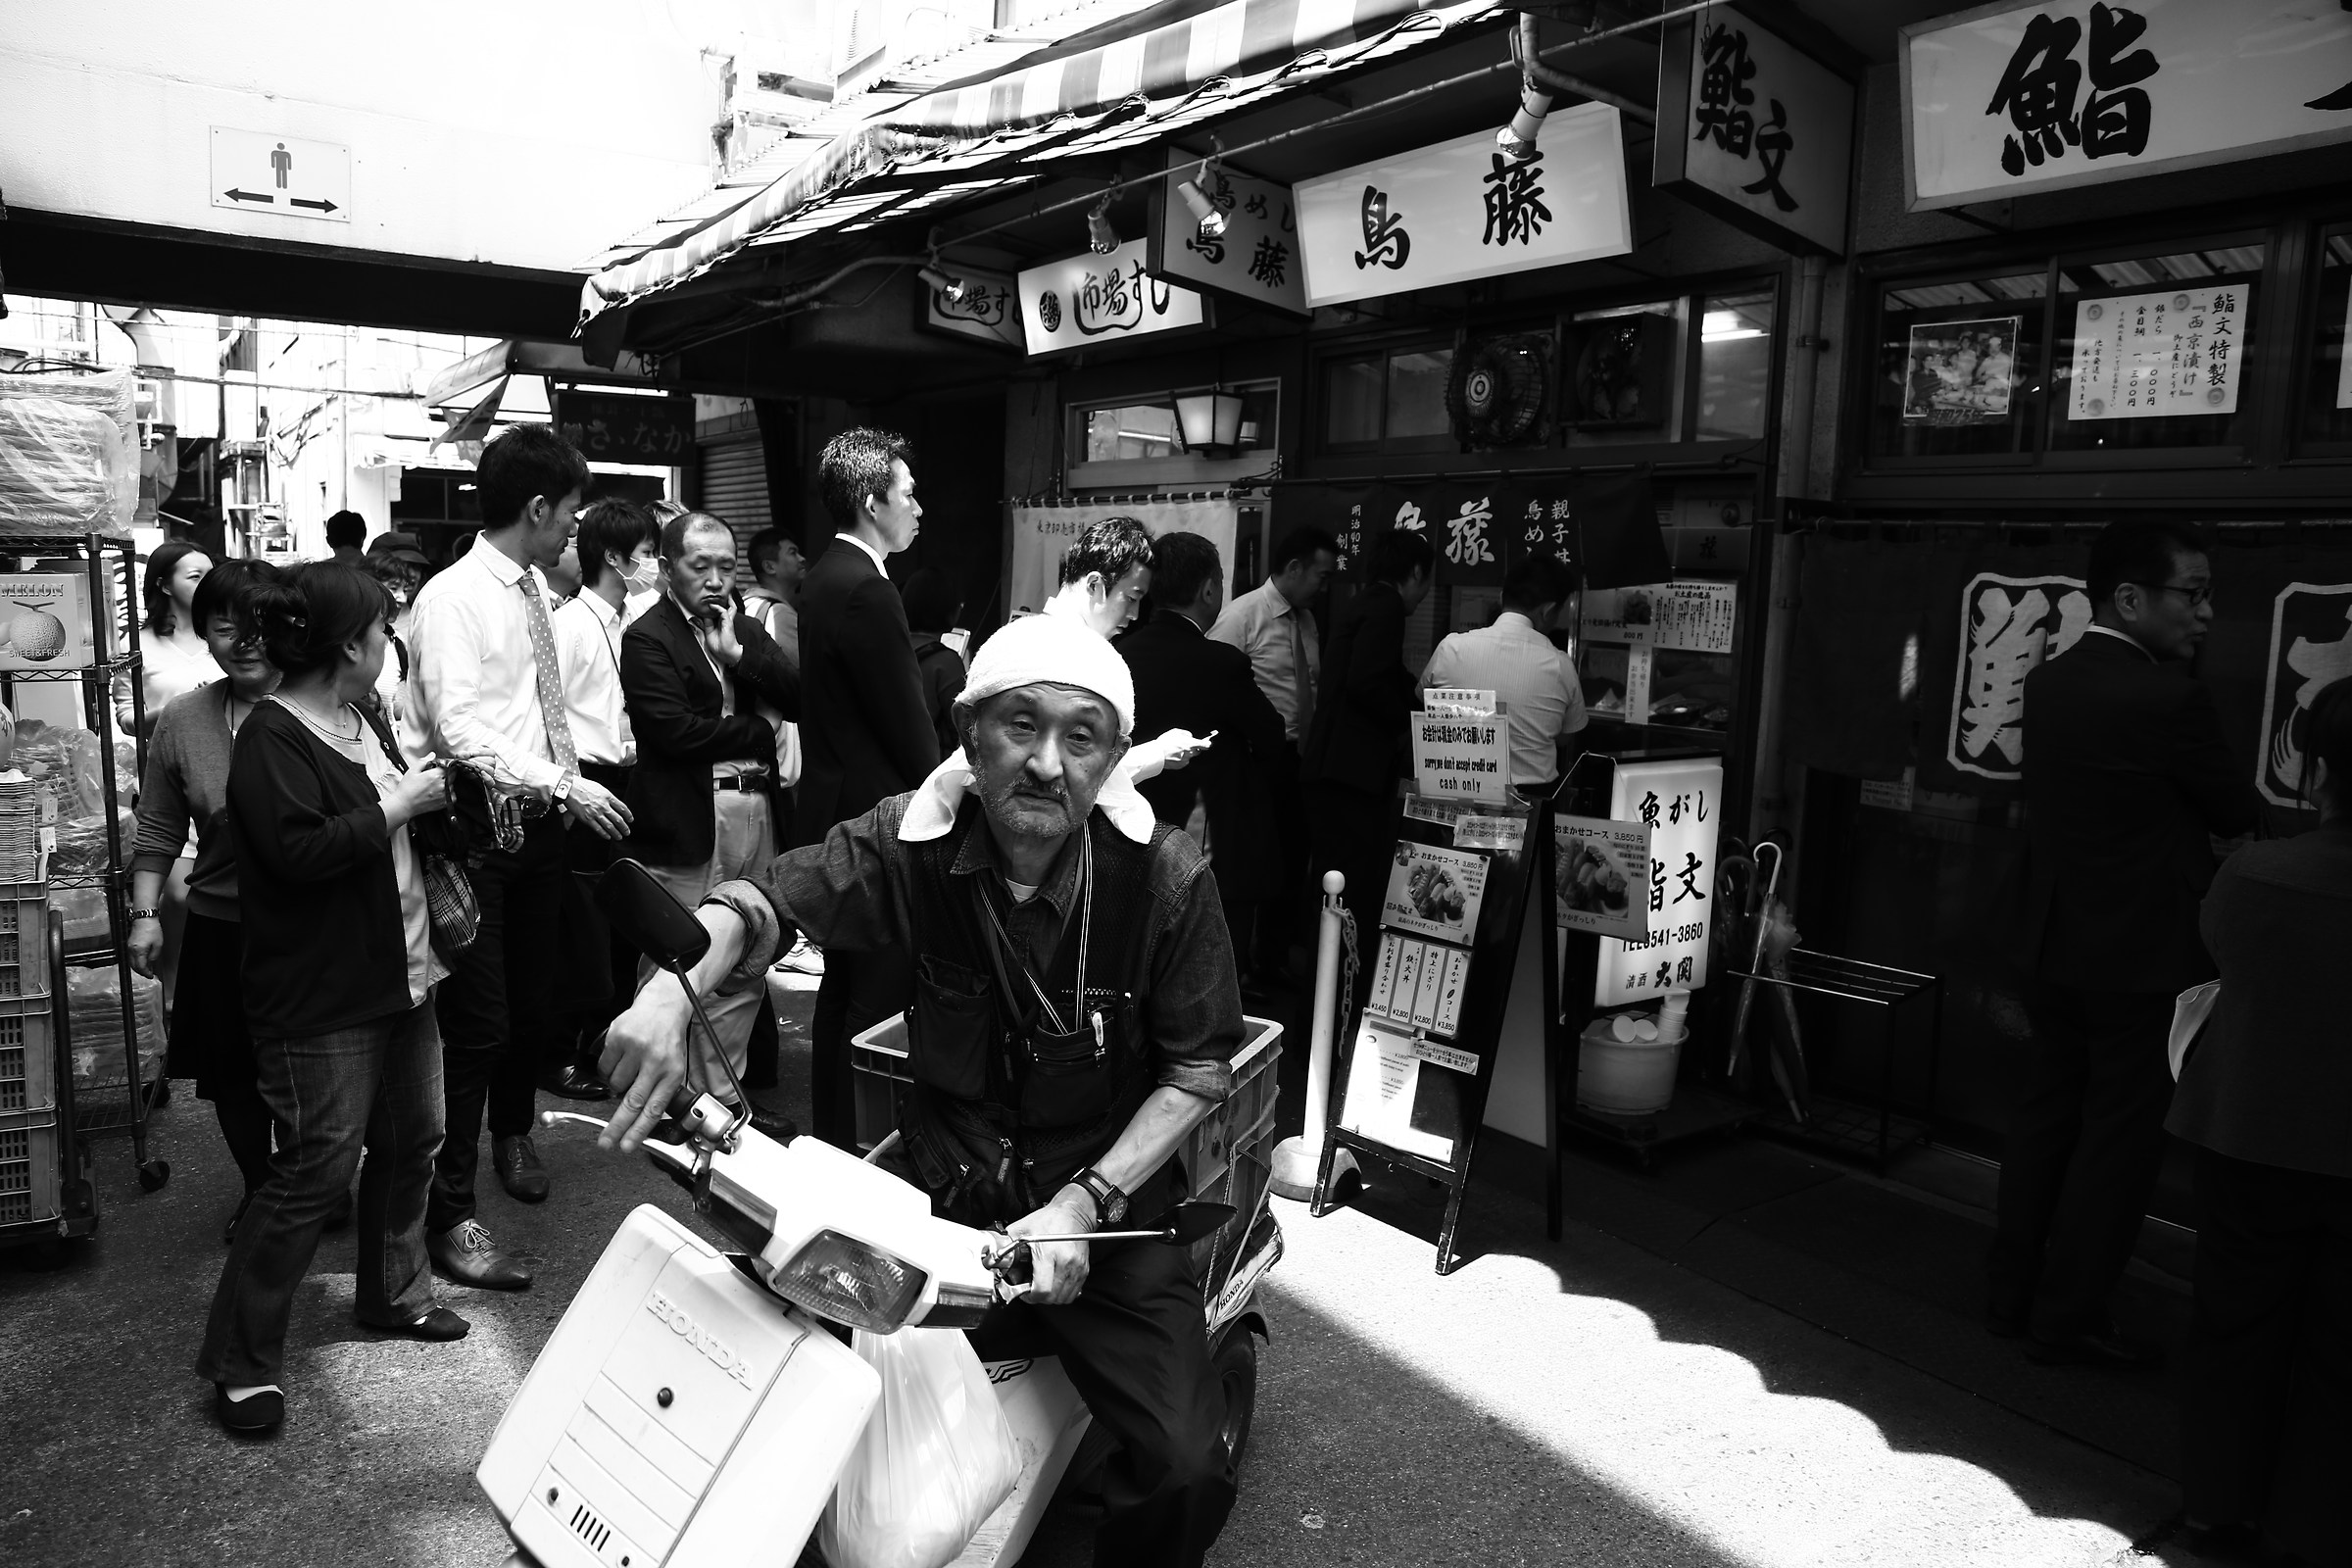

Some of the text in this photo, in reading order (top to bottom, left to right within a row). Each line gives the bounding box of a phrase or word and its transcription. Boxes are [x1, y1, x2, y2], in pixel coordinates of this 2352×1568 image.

[1695, 24, 1799, 213] 鮨文
[1209, 170, 1296, 233] 鳥めし
[1354, 150, 1554, 271] 鳥藤
[1073, 259, 1171, 335] 市場すし
[2133, 306, 2147, 337] 金目鯛
[2154, 304, 2166, 335] 銀だら
[2179, 305, 2207, 397] 『西京漬け』
[2207, 293, 2235, 386] 鮨文特製
[1350, 503, 1362, 557] 明治40年
[1336, 533, 1348, 572] 創業
[0, 583, 64, 598] MELON
[9, 648, 71, 659] SWEET&FRESH
[1422, 724, 1495, 745] お会計は現金のみでお願いします
[1455, 757, 1471, 773] accept
[1471, 758, 1486, 772] credit
[1486, 759, 1497, 773] card
[1439, 777, 1481, 793] cash only
[1639, 790, 1710, 830] 魚がし
[1554, 824, 1644, 844] おまかせコース 3,850円
[1421, 852, 1459, 866] おまかせコース
[1397, 916, 1439, 932] 最高のネタがぎっしり
[1393, 954, 1414, 1019] 鉄火丼 ¥2,800
[1414, 951, 1439, 1025] 特上にぎり ¥2,800
[1626, 956, 1693, 989] 清酒 大関
[1438, 956, 1462, 1031] おまかせ コース ¥3,850
[1219, 1280, 1244, 1310] HONDA
[646, 1290, 754, 1392] HONDA
